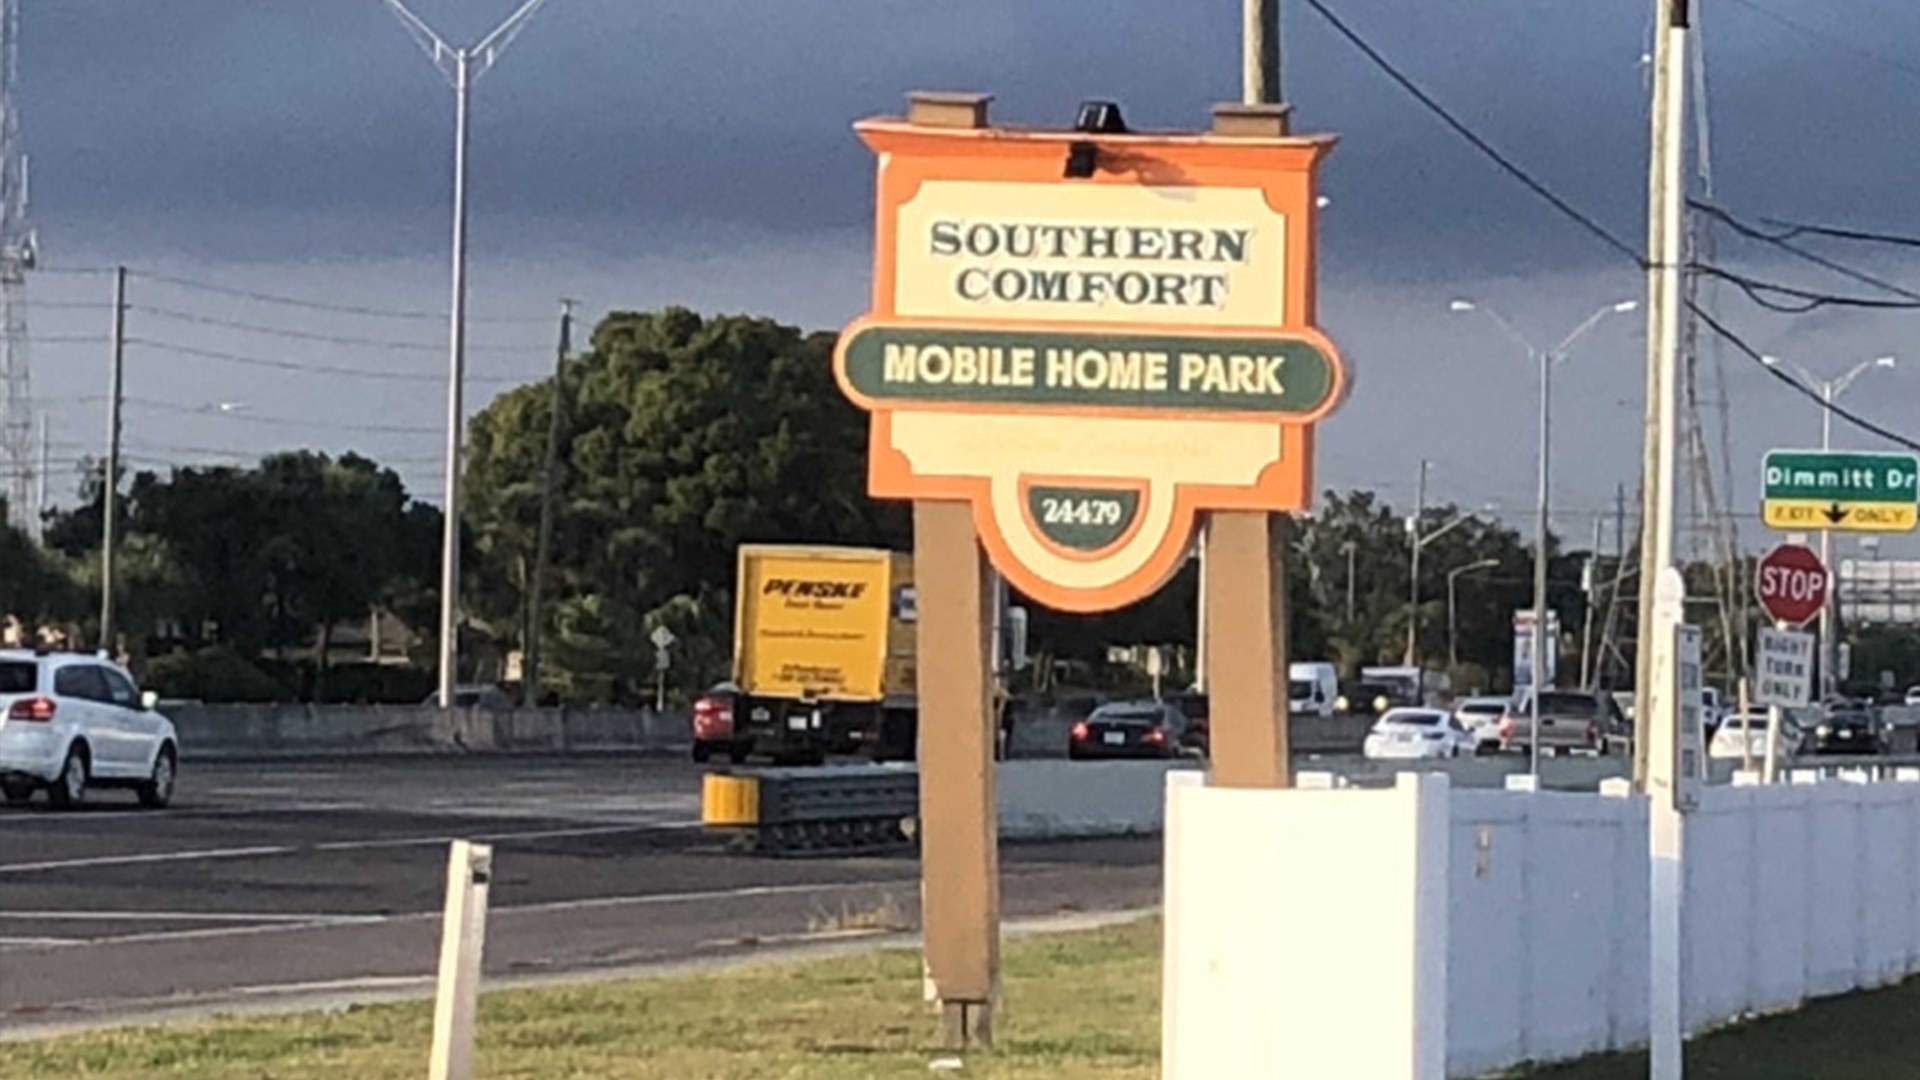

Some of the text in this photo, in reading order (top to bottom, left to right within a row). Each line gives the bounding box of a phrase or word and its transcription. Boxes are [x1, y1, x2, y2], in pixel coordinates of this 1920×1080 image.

[930, 221, 1250, 262] SOUTHERN
[956, 267, 1227, 306] COMFORT
[884, 345, 1285, 395] MOBILE HOME PARK
[1765, 466, 1916, 490] Dimmitt Dr
[1042, 497, 1121, 526] 24479
[1855, 507, 1905, 524] ONLY
[763, 579, 867, 598] PENSKE
[1761, 566, 1824, 601] STOP
[1762, 679, 1801, 700] ONLY
